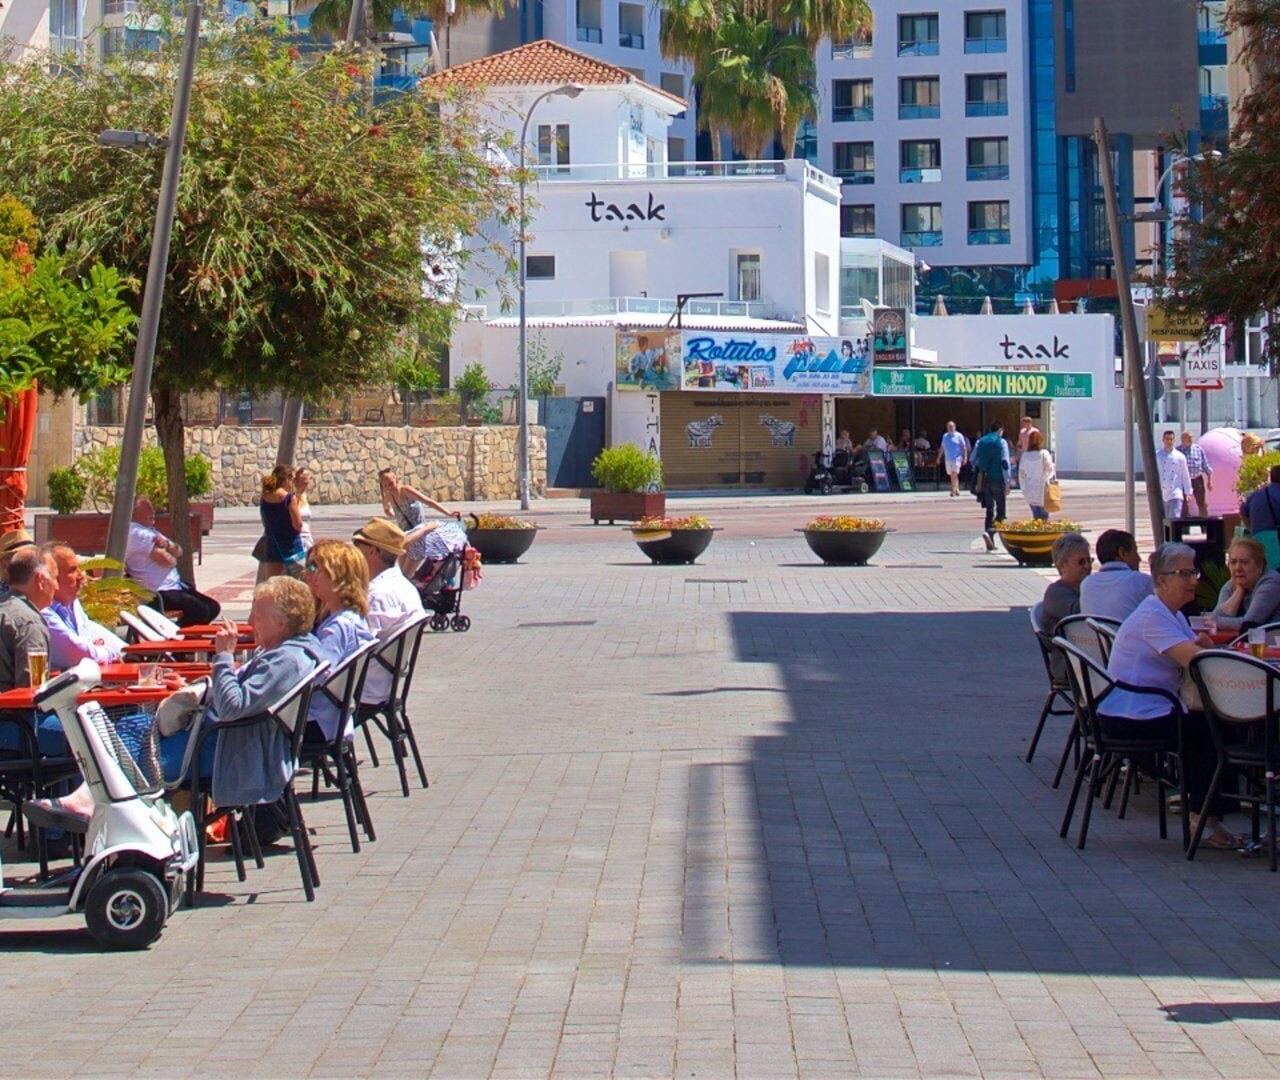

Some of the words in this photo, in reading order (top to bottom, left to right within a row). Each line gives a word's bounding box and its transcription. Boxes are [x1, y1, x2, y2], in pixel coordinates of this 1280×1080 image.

[585, 191, 666, 222] taak
[999, 334, 1070, 359] taak
[1187, 360, 1218, 371] TAXIS
[924, 373, 952, 394] The
[955, 373, 1002, 394] ROBIN
[1006, 373, 1047, 394] HOOD
